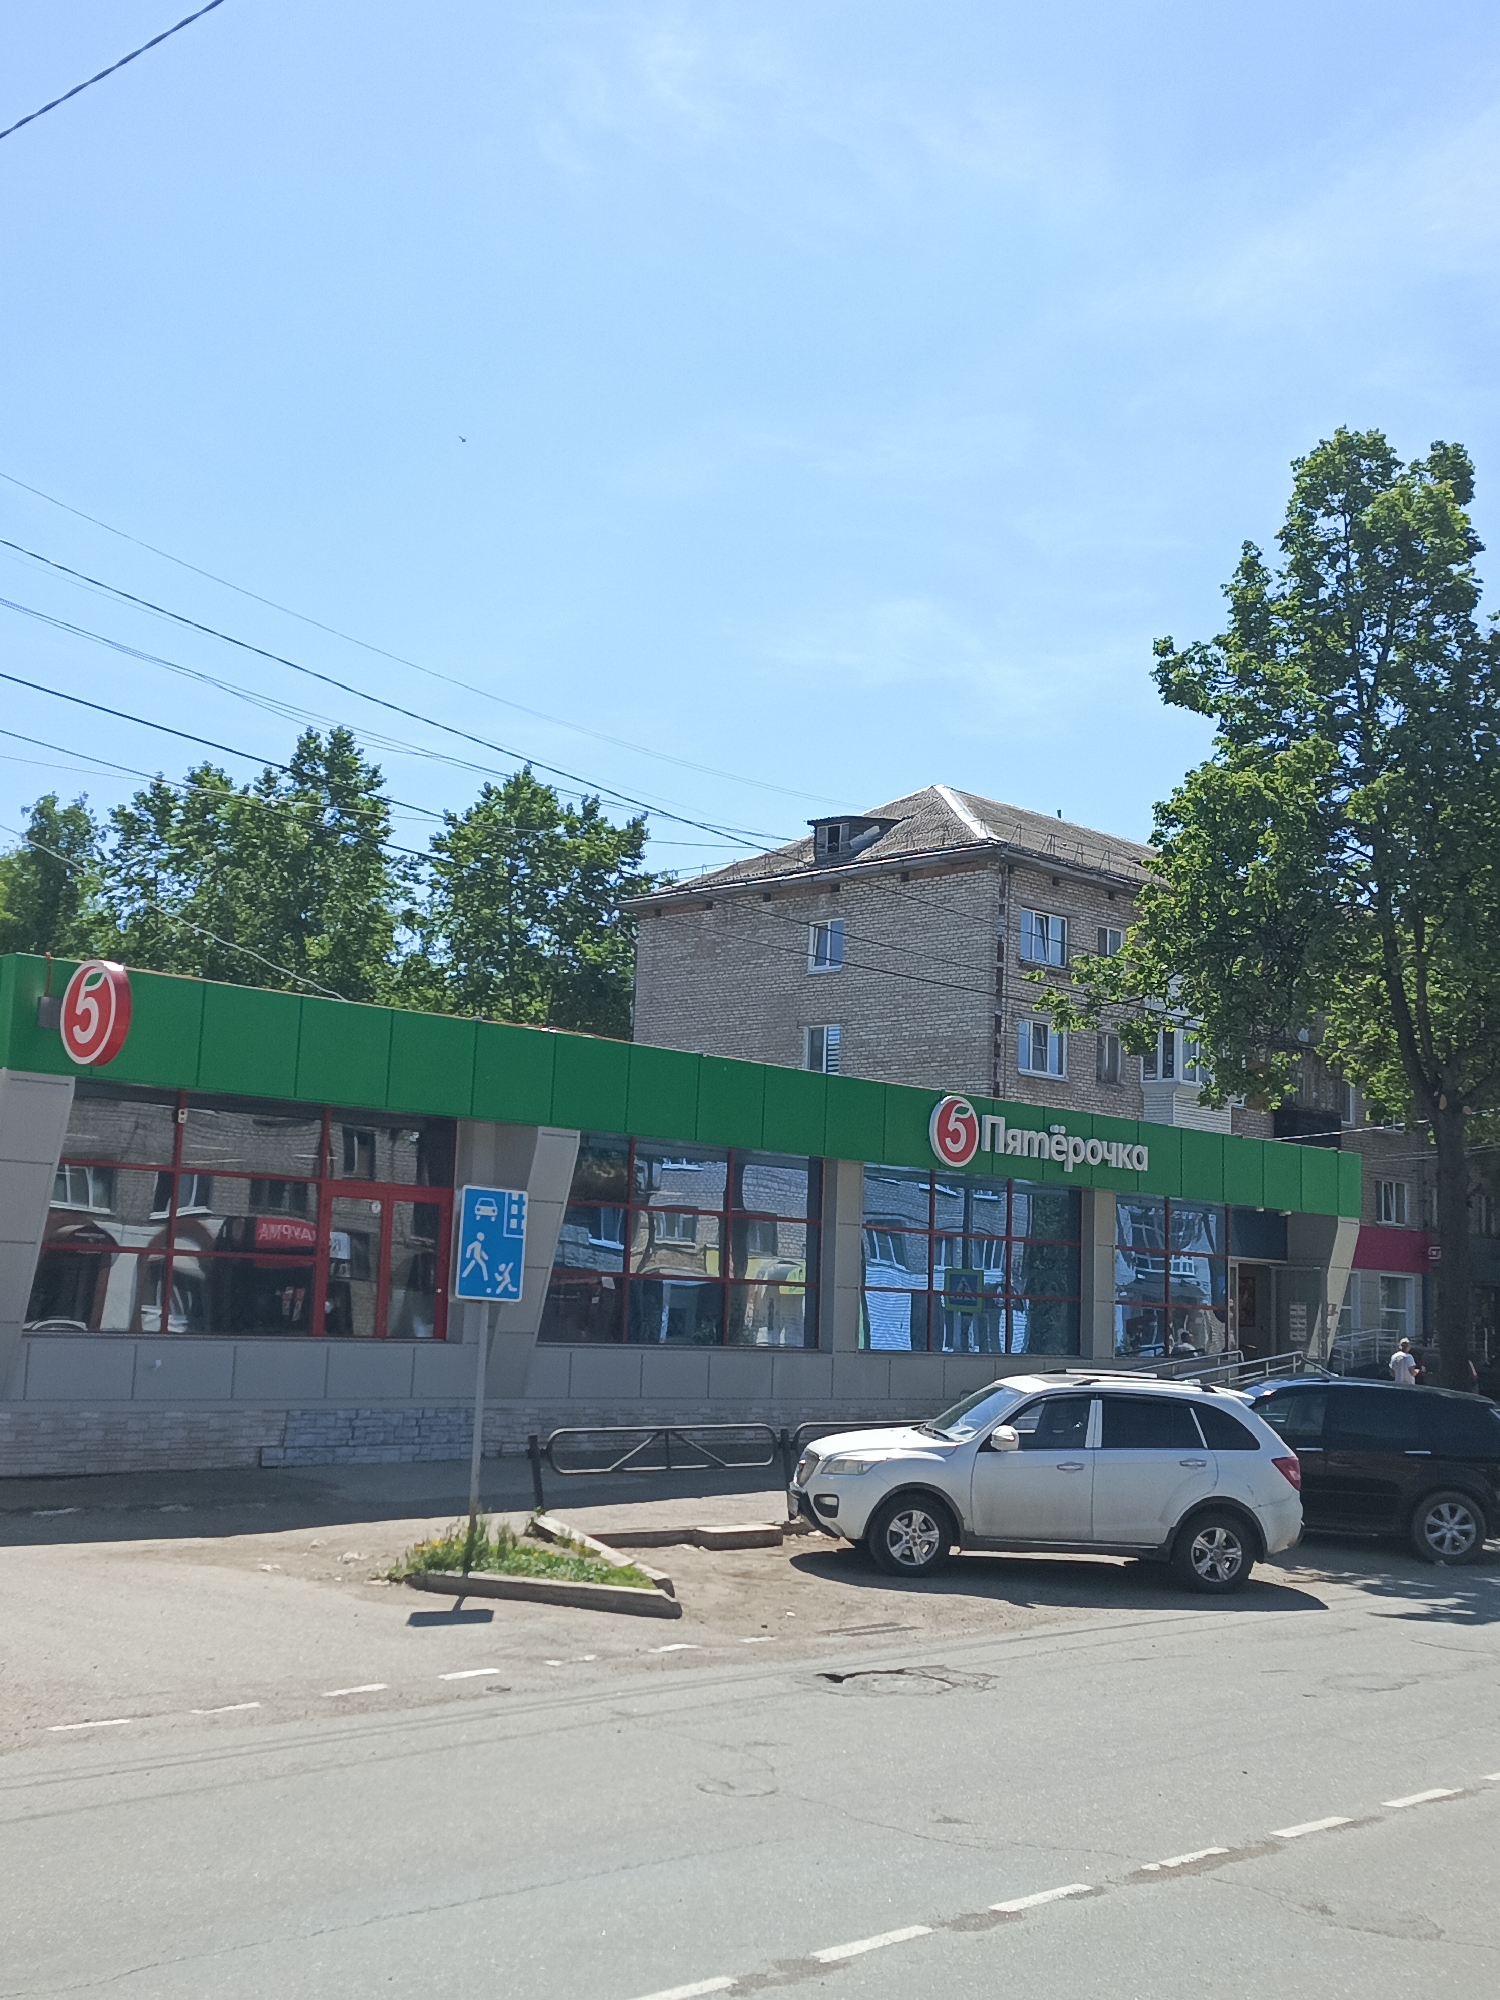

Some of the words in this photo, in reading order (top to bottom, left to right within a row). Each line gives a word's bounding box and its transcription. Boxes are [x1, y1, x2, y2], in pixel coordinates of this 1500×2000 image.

[73, 967, 106, 1044] 5
[945, 1102, 972, 1153] 5
[981, 1114, 1149, 1173] Пятёрочка
